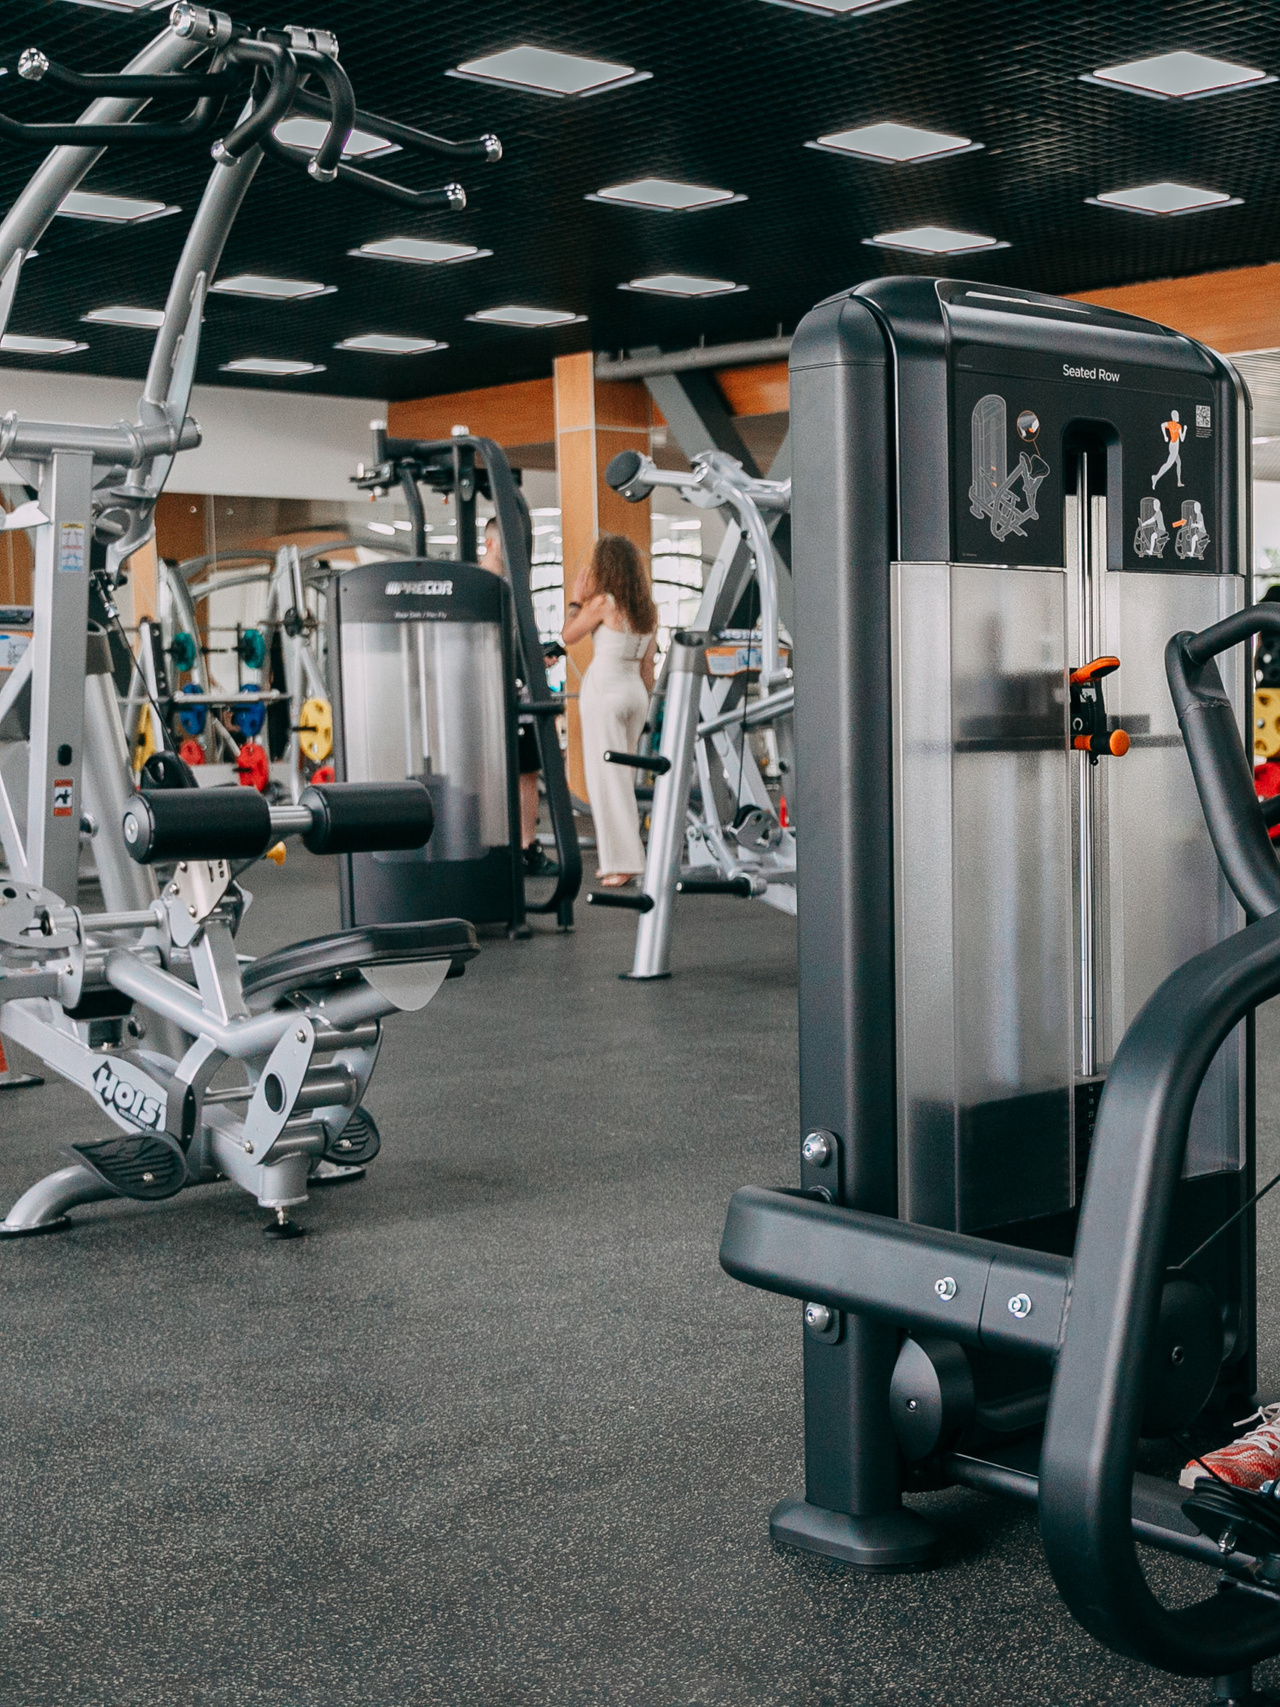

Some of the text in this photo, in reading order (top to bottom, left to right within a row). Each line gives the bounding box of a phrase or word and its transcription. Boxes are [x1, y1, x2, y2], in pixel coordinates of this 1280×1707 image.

[1062, 363, 1120, 382] Seated Row
[398, 580, 453, 596] PRECOR
